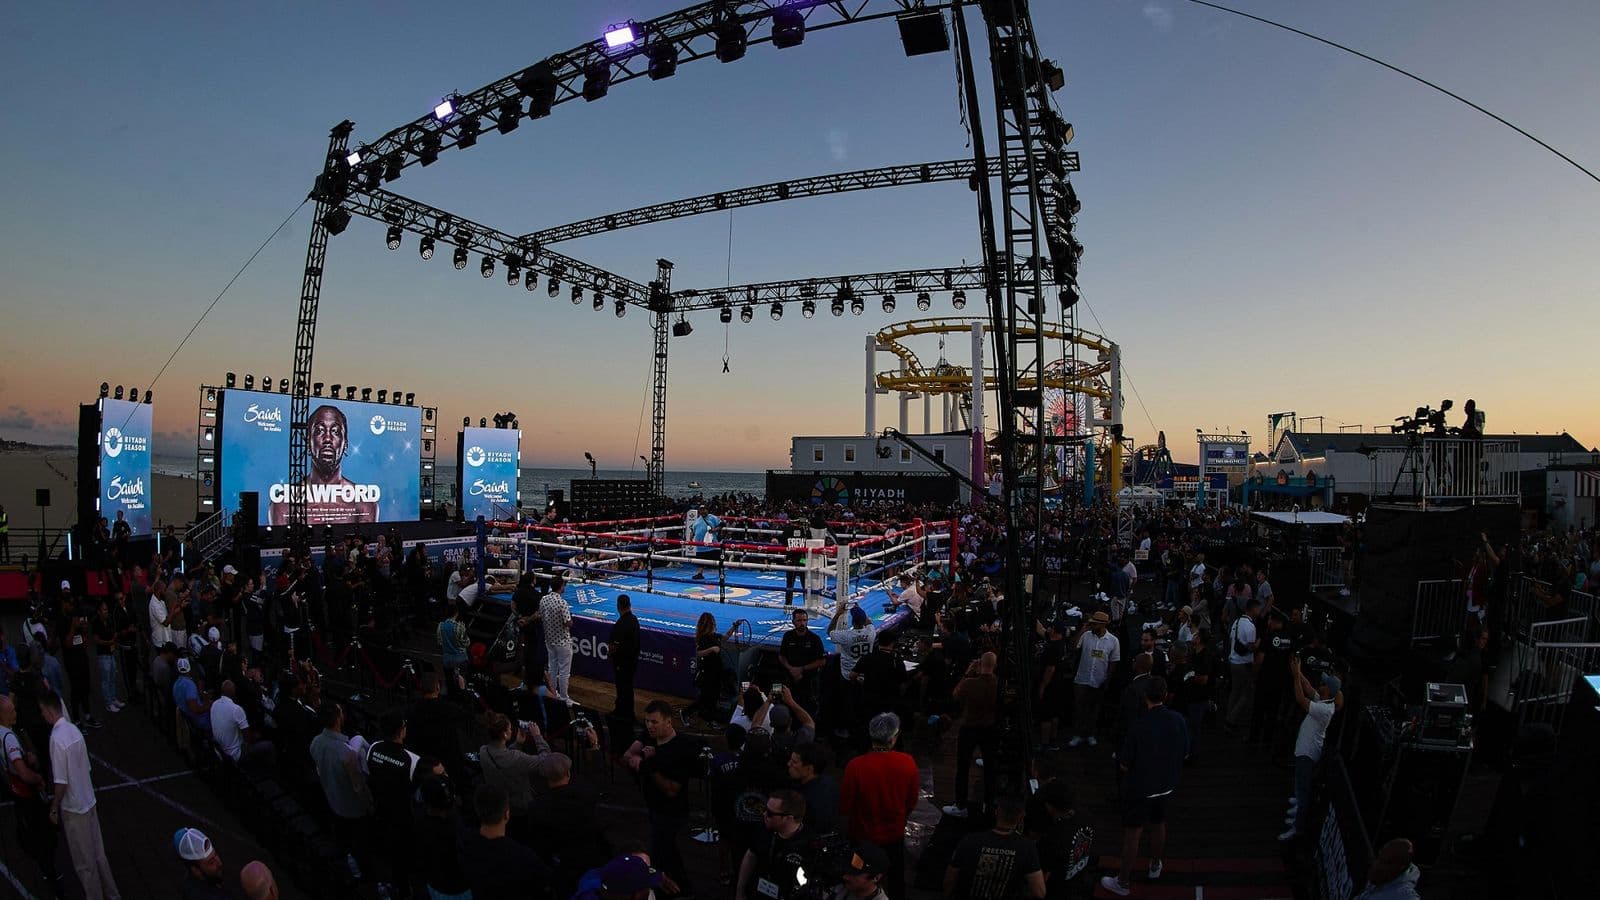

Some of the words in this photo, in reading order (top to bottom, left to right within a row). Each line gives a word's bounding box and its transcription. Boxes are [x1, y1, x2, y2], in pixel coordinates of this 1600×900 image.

[124, 436, 146, 444] RIYADH
[854, 488, 905, 498] RIYADH
[850, 643, 870, 659] 99
[981, 847, 1017, 856] FREEDOM
